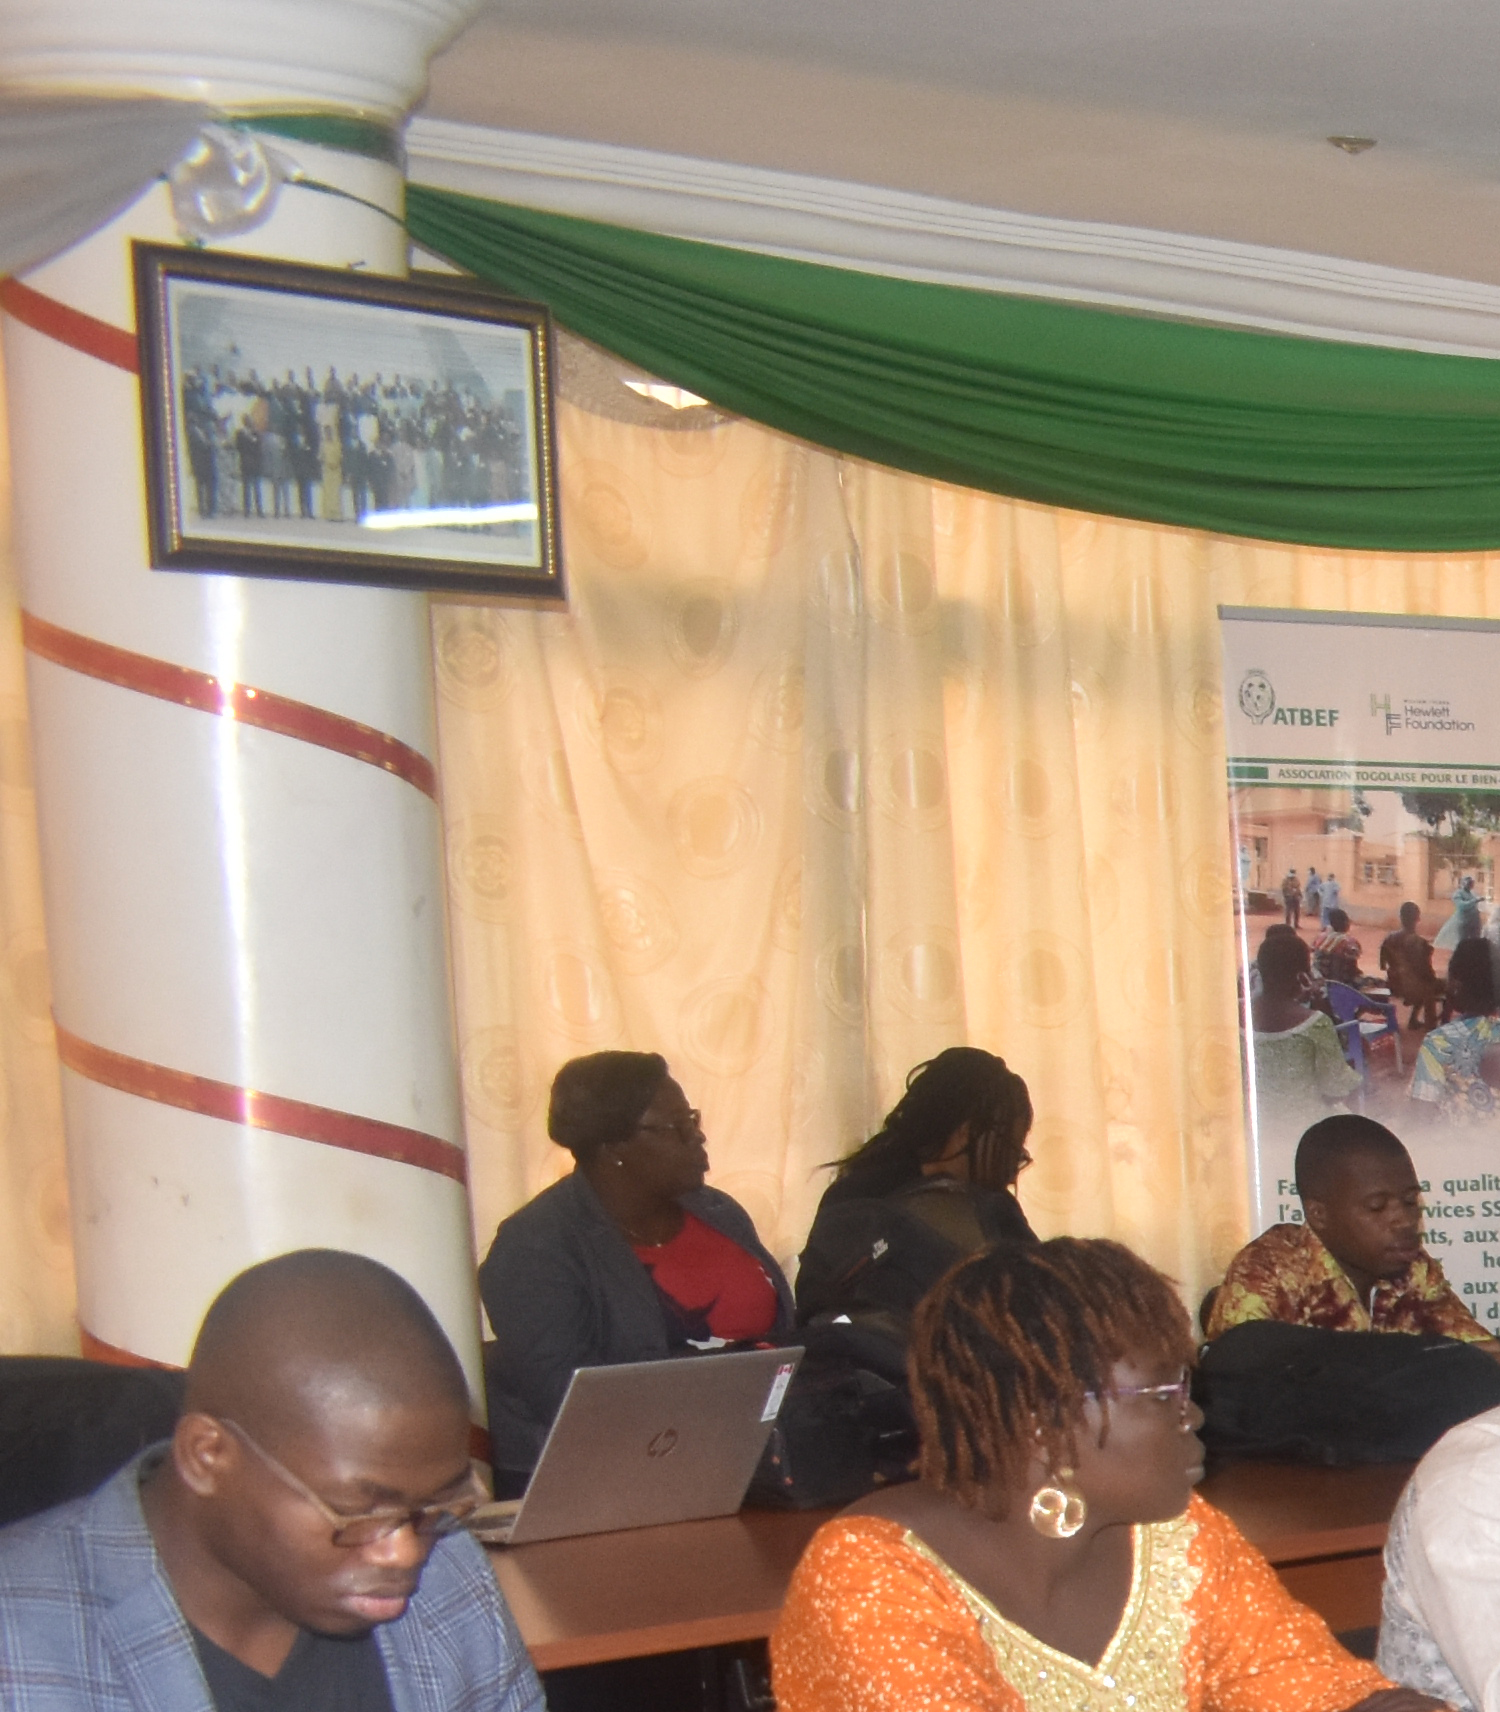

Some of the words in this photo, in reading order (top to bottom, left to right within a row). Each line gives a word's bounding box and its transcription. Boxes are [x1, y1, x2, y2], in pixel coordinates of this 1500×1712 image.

[1273, 708, 1340, 728] ATBEF
[1405, 705, 1450, 718] Hewlett
[1405, 717, 1475, 731] Foundation
[1278, 768, 1350, 781] ASSOCIATION
[1355, 770, 1416, 783] TOGOLAISE
[1421, 772, 1452, 784] POUR
[1456, 773, 1468, 784] LE
[1421, 1201, 1475, 1218] rvices
[1463, 1229, 1499, 1243] aux
[1463, 1280, 1498, 1295] aux
